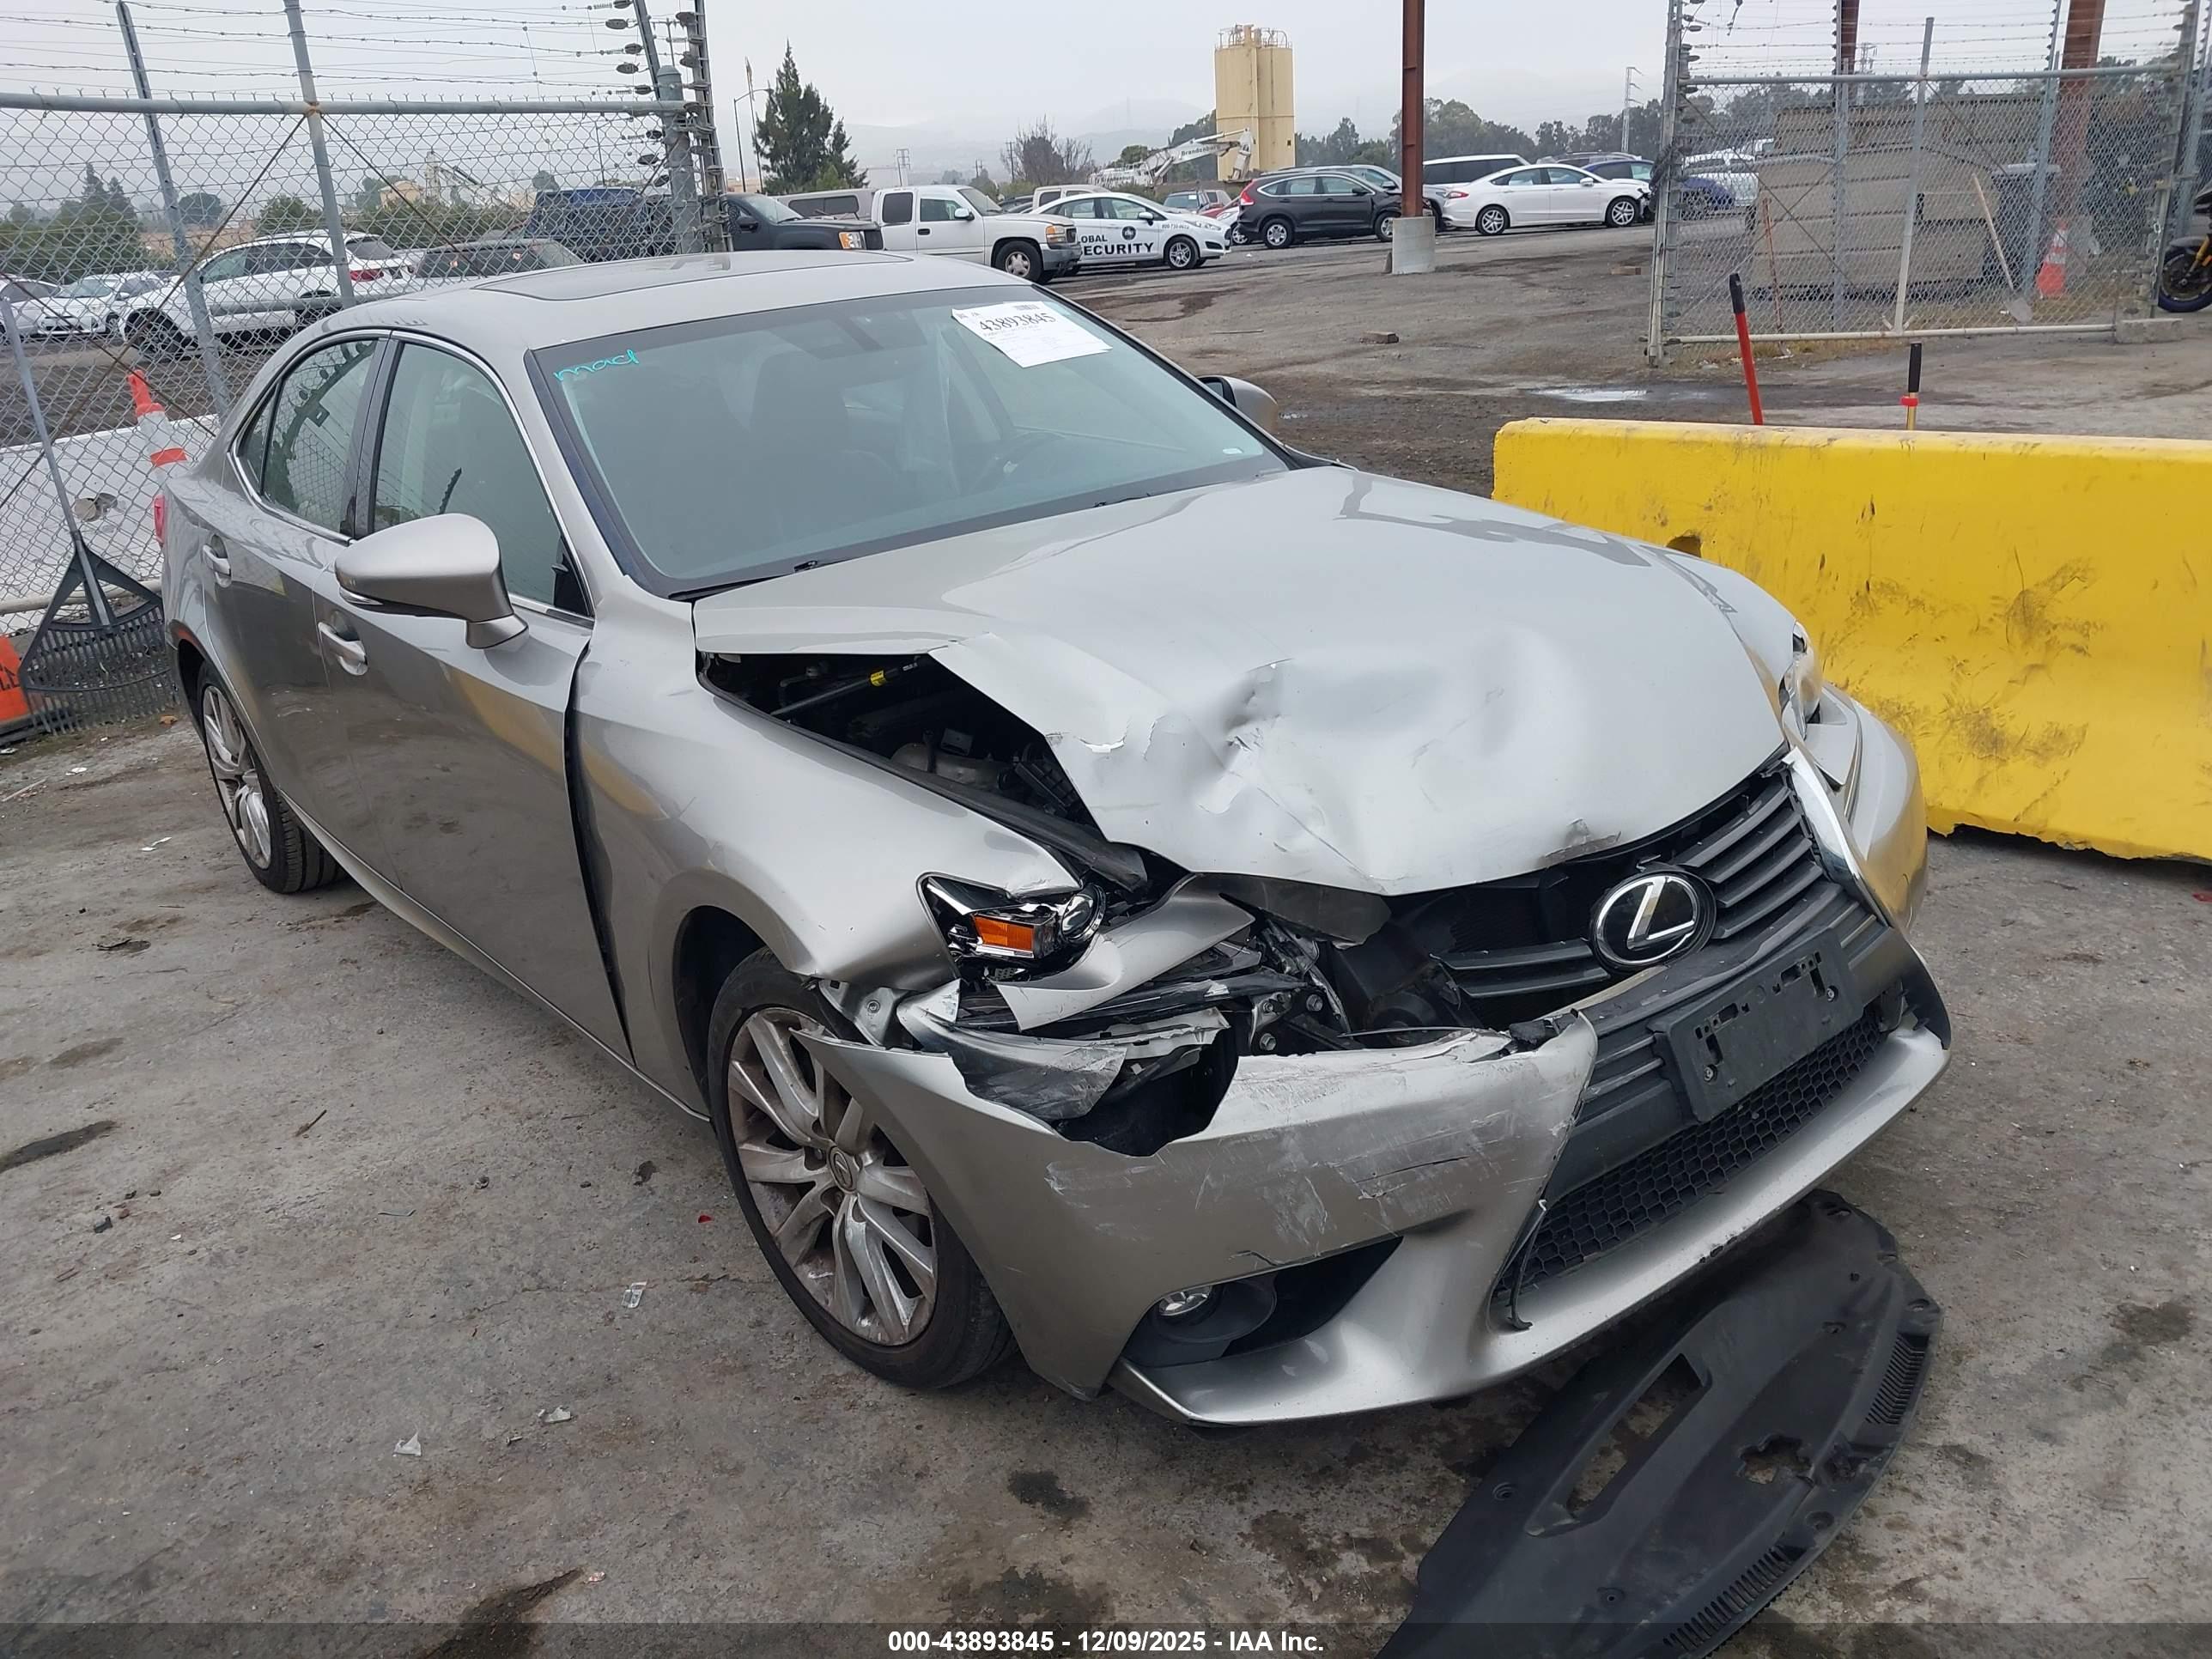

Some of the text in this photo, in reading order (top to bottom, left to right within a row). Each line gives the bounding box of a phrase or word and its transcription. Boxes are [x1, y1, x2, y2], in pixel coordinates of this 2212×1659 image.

[1081, 234, 1108, 243] OBAL
[1083, 242, 1154, 256] ECURITY
[980, 313, 1056, 331] 43893845
